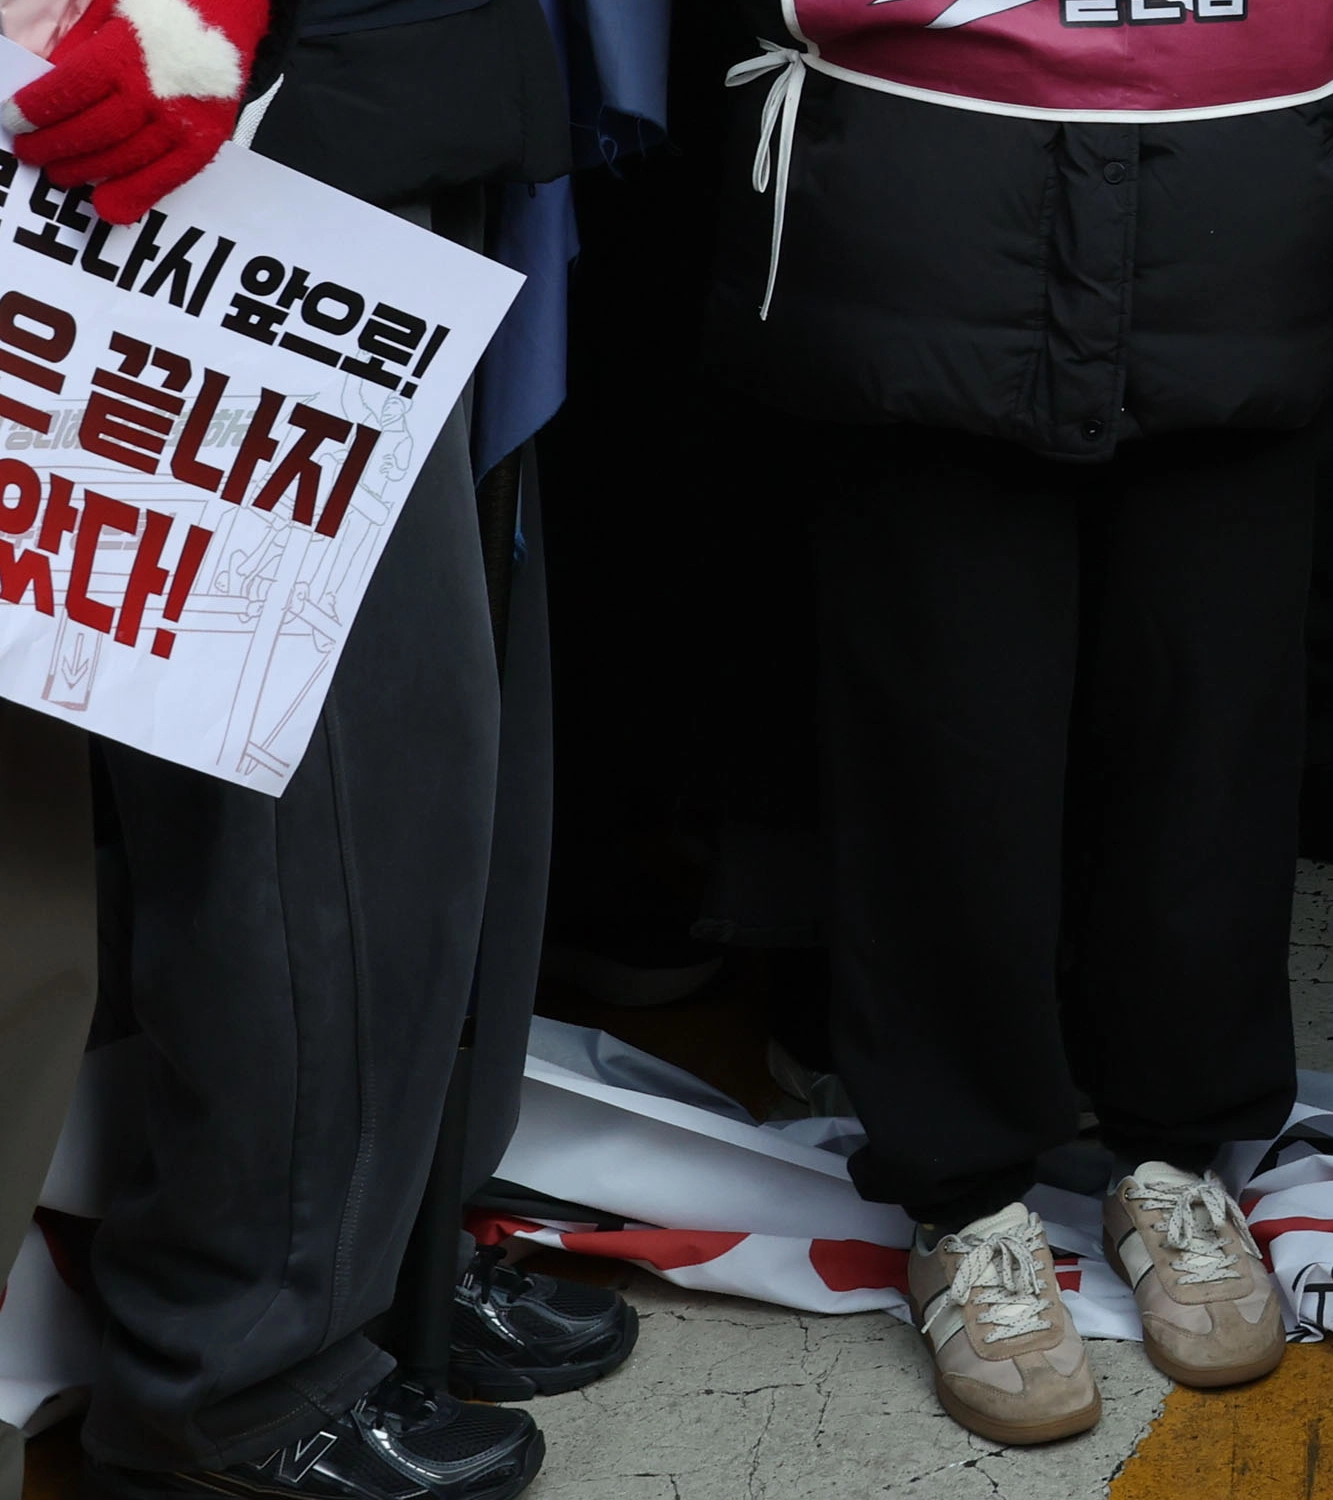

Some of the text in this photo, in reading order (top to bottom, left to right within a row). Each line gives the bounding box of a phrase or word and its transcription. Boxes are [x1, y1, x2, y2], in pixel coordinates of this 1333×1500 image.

[12, 165, 236, 318] 또다시
[221, 256, 451, 398] 앞으로!
[79, 331, 381, 538] 끝나지
